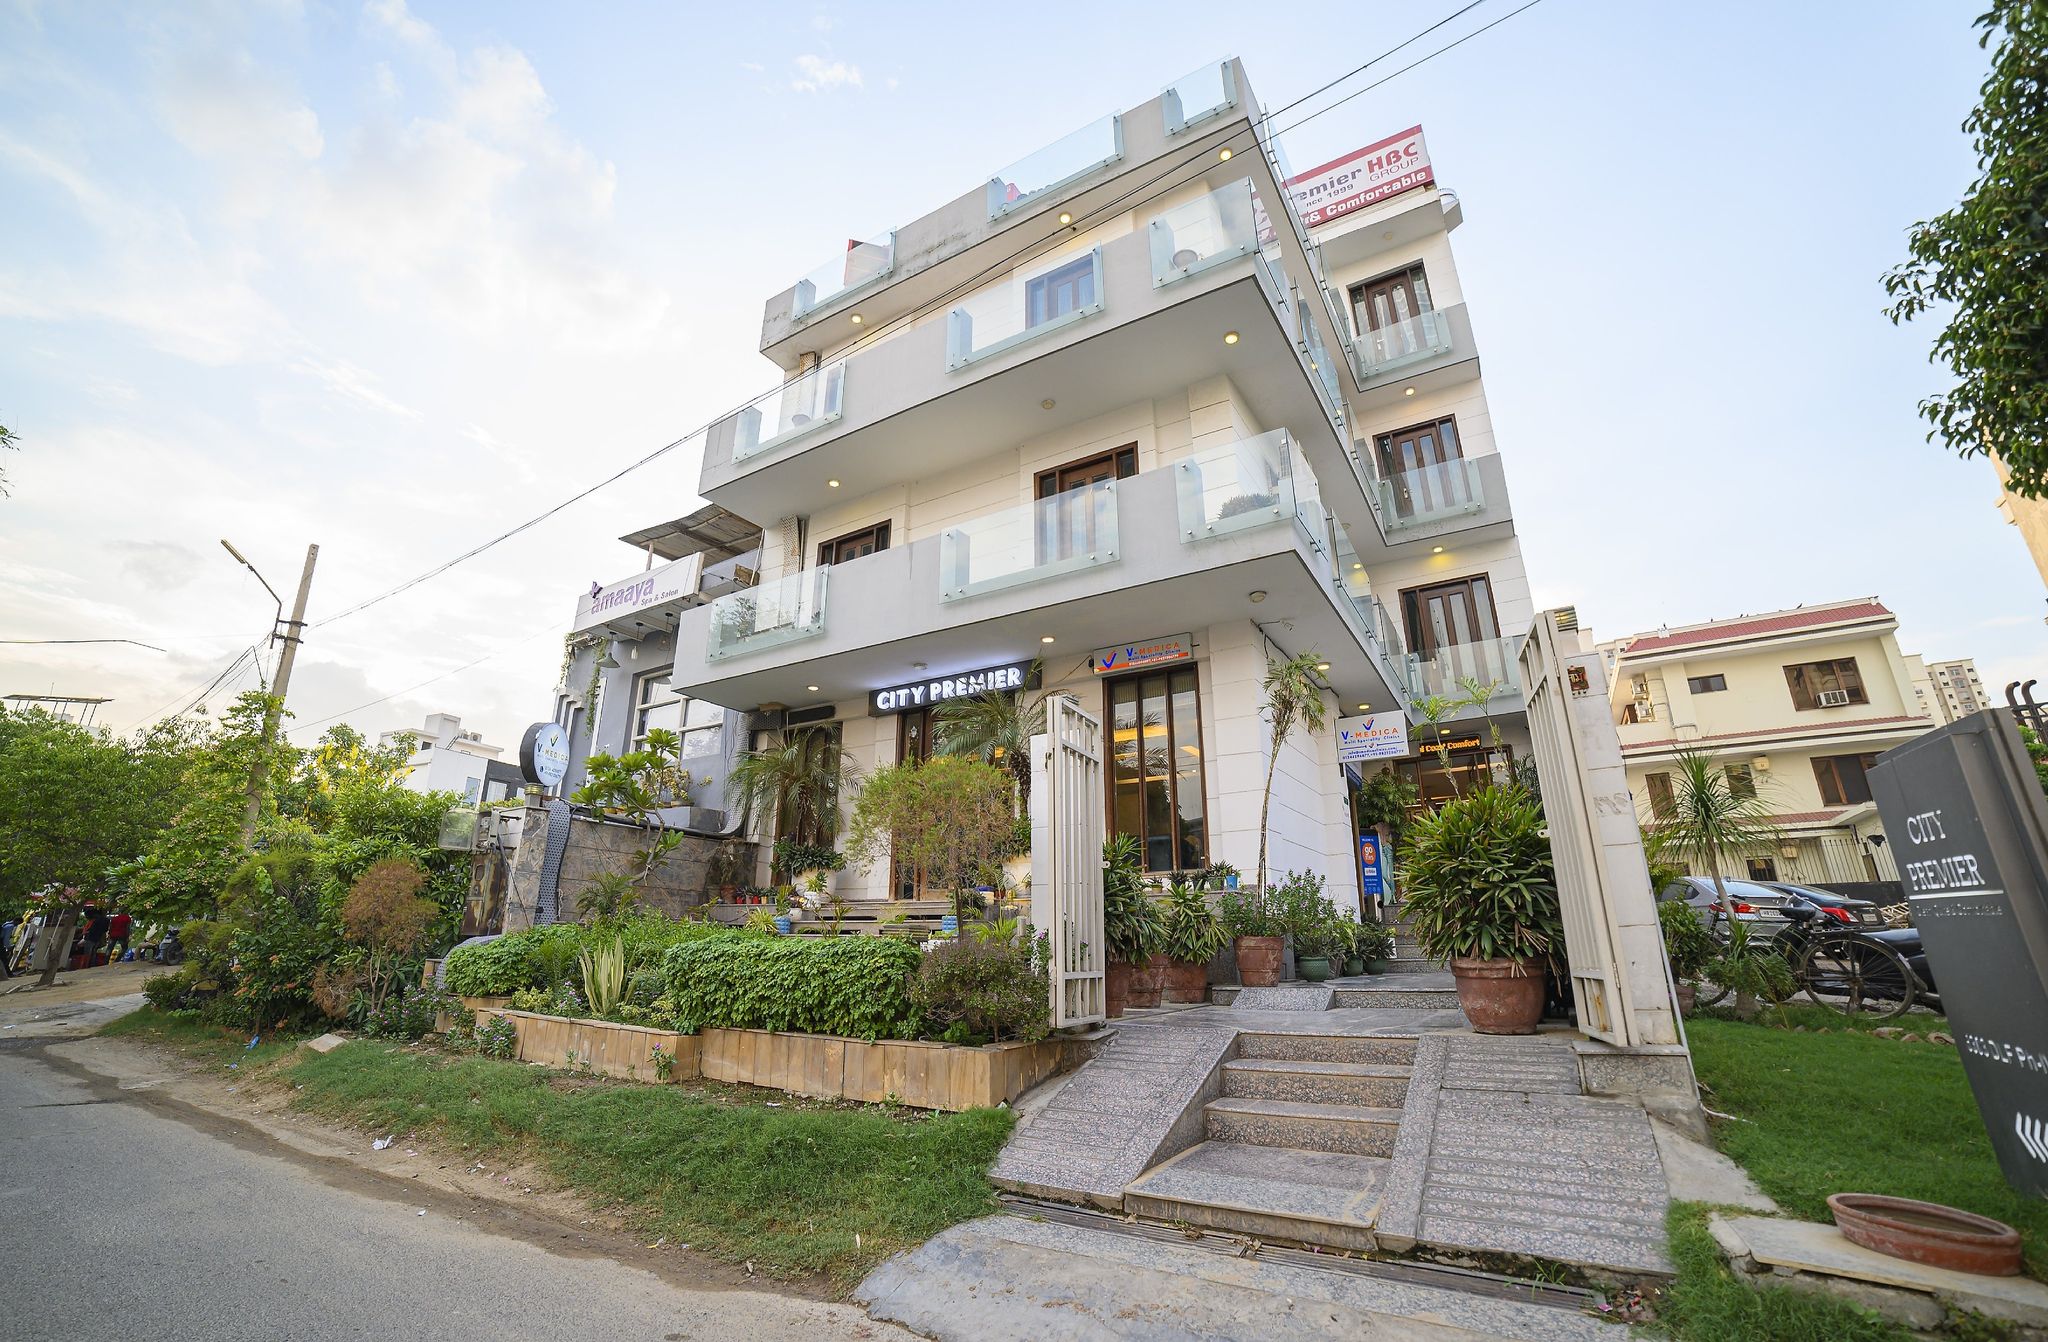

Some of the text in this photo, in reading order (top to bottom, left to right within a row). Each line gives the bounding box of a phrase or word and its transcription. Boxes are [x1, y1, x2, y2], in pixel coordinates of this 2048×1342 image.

[1367, 142, 1419, 174] HBC
[1369, 157, 1419, 182] GROUP
[1326, 170, 1427, 217] Comfortable
[1327, 183, 1354, 200] 1999
[591, 577, 655, 615] amaaya
[876, 667, 1022, 710] CITY PREMIER
[1447, 739, 1480, 750] Comfort
[1907, 810, 1946, 845] CITY
[1364, 847, 1373, 856] go
[1906, 854, 1985, 891] PREMIER
